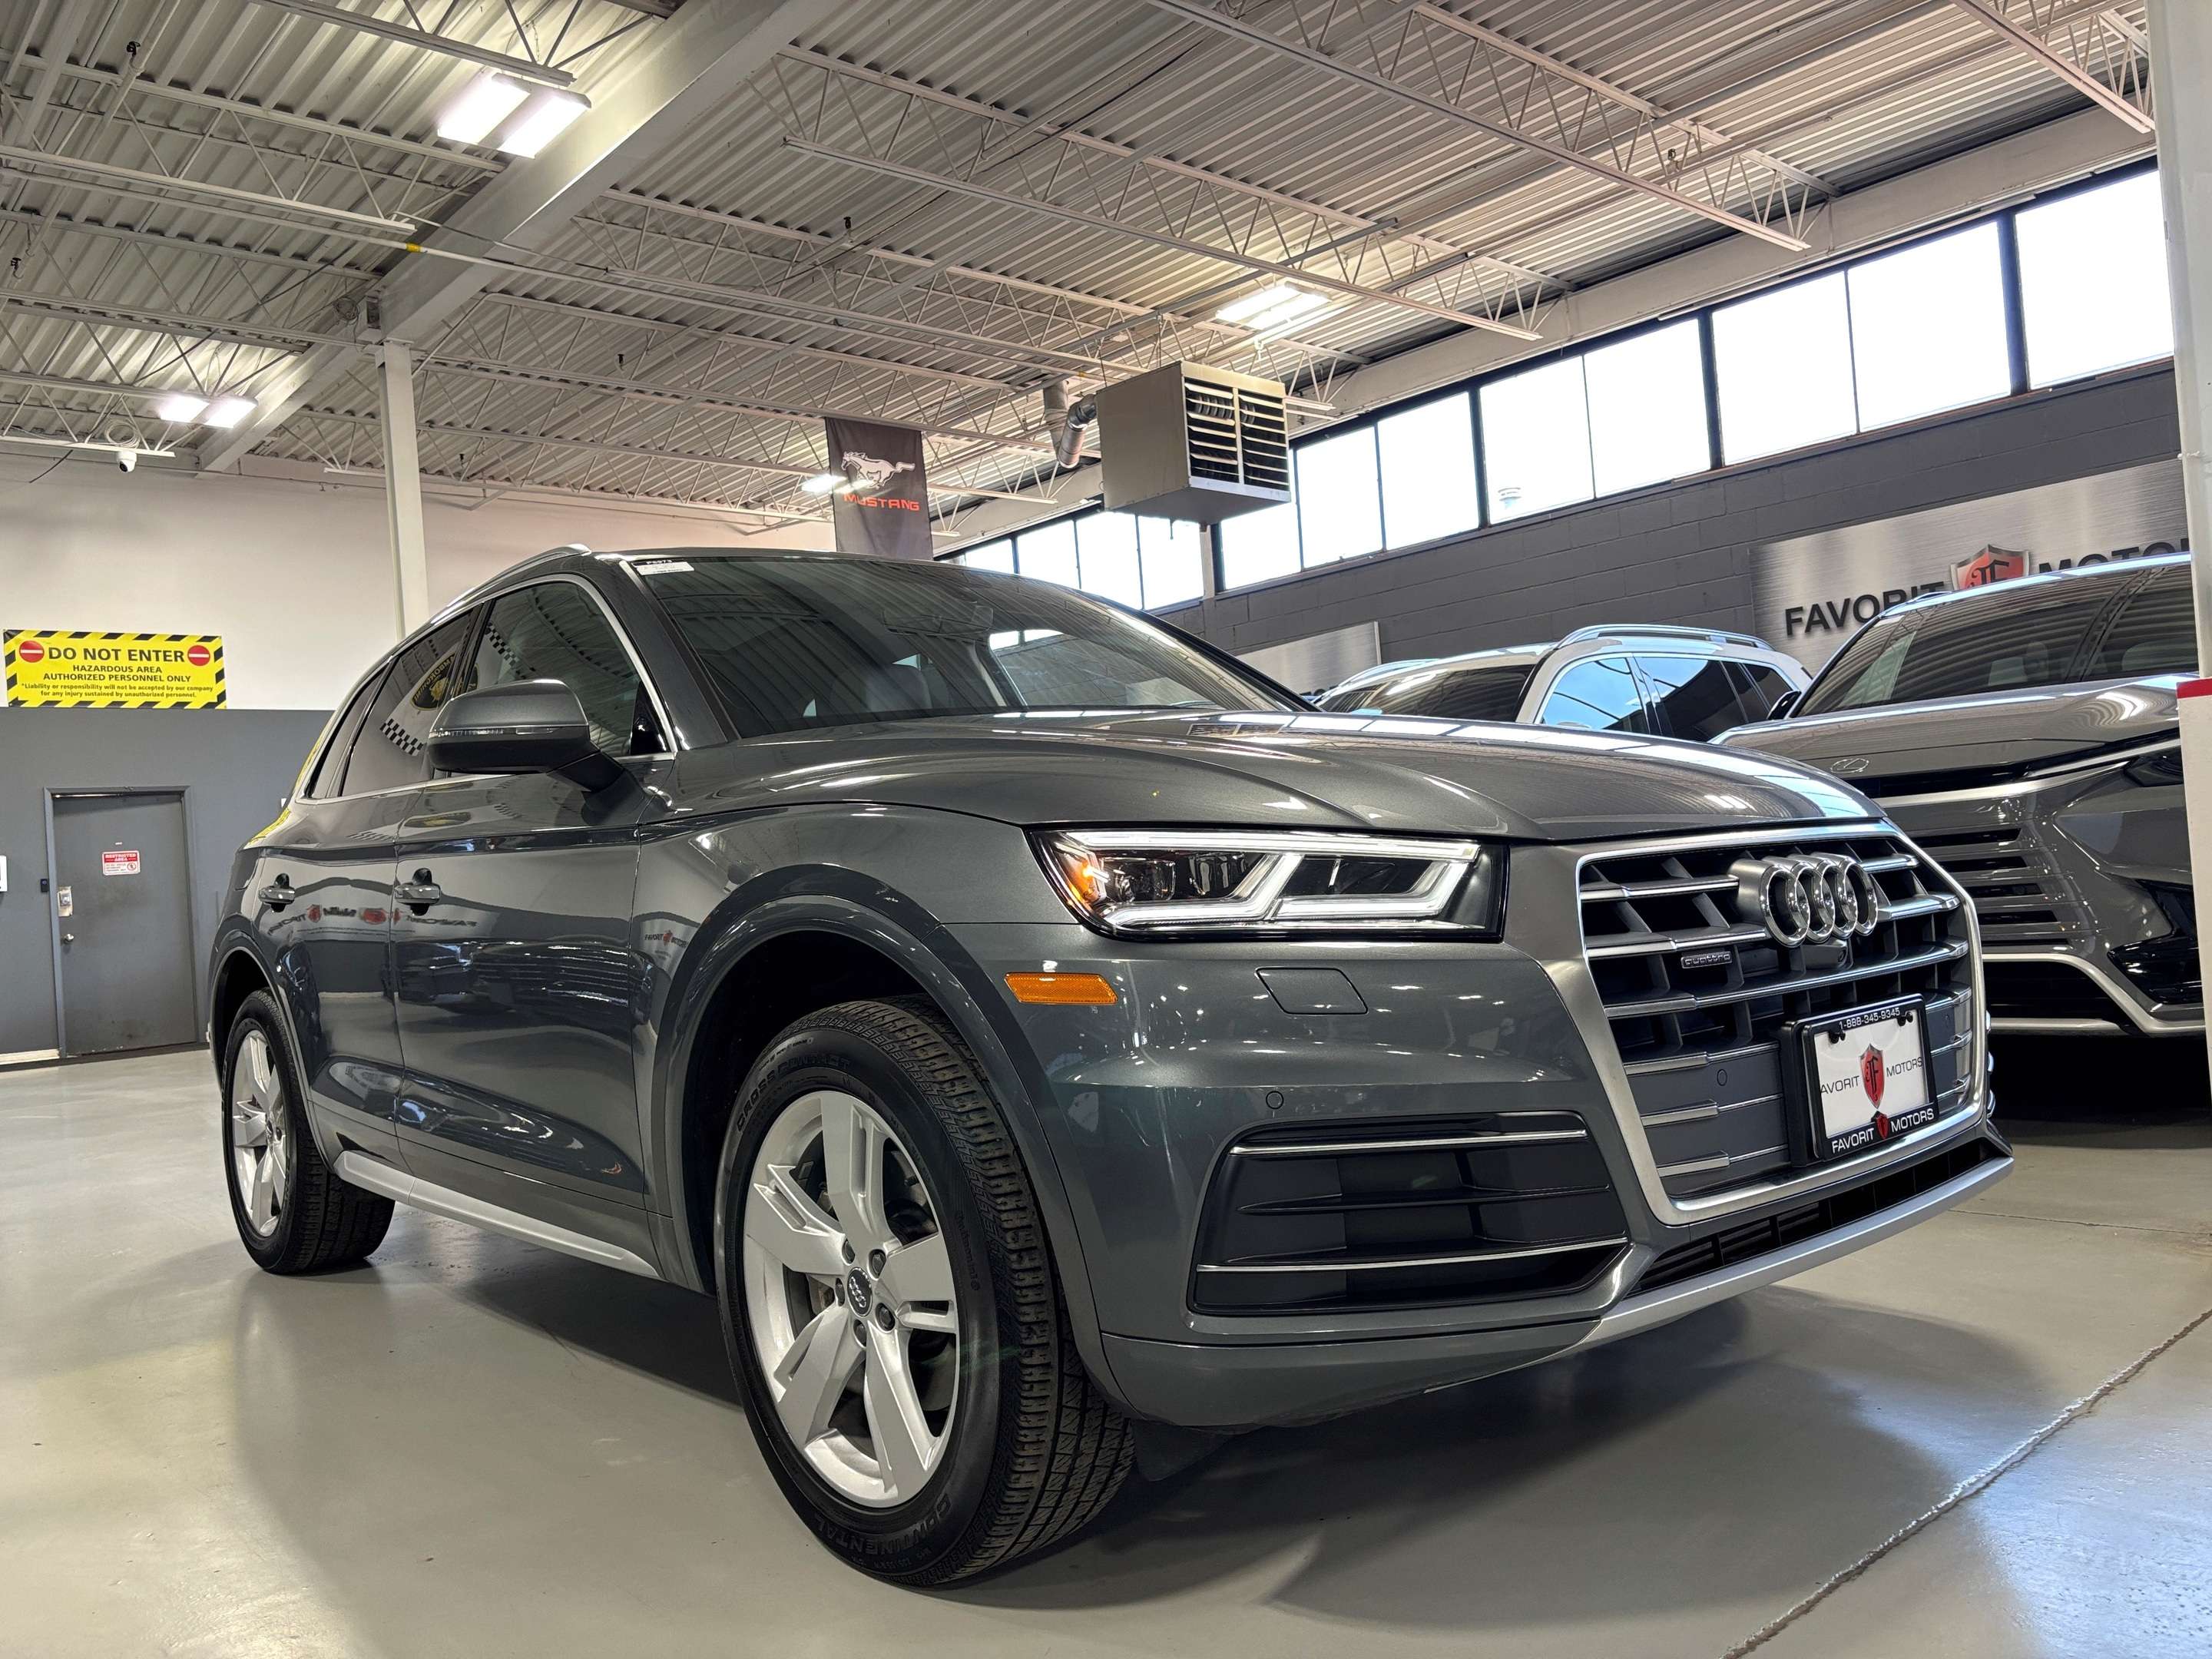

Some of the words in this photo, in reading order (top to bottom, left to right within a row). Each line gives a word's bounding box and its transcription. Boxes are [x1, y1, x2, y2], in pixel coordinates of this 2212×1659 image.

[843, 493, 920, 511] MUSTANG
[48, 647, 77, 661] DO
[84, 648, 121, 661] NOT
[128, 649, 184, 662] ENTER
[43, 673, 105, 681] AUTHORIZED
[108, 674, 164, 682] PERSONNEL
[1839, 1007, 1901, 1029] 1-888-345-9345
[1820, 1075, 1860, 1094] AVORIT
[1886, 1057, 1922, 1077] MOTORS
[1832, 1128, 1874, 1153] FAVORIT
[1891, 1108, 1934, 1133] MOTORS
